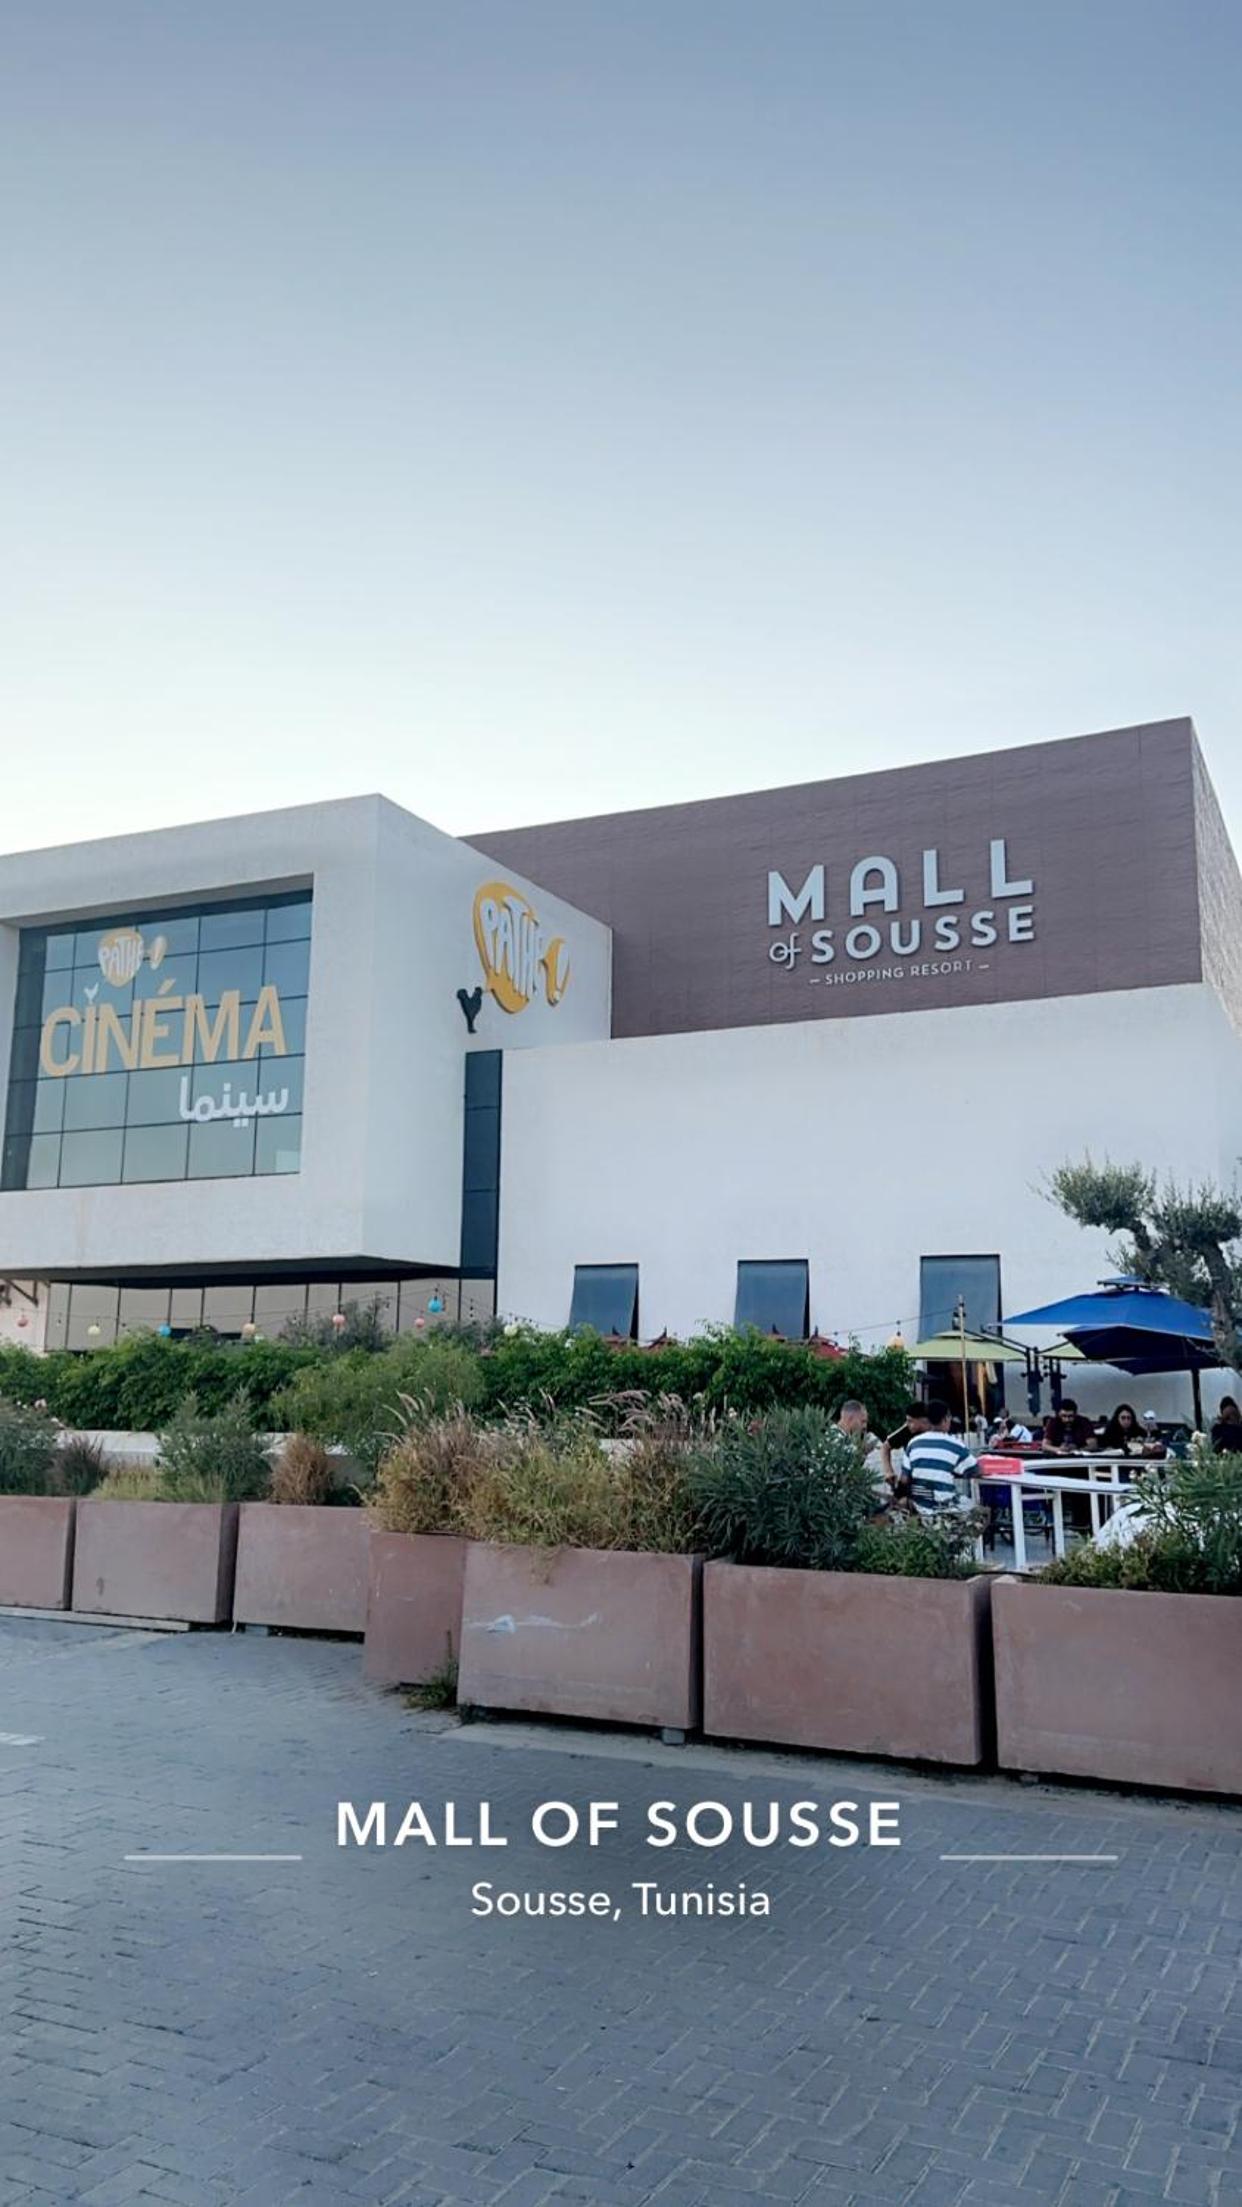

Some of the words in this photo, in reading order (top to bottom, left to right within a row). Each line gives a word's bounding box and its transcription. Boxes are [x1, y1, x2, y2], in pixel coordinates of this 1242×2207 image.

[767, 839, 1034, 926] MALL
[769, 932, 802, 970] of
[811, 905, 1035, 965] SOUSSE
[825, 966, 905, 986] SHOPPING
[910, 959, 974, 977] RESORT
[179, 1075, 289, 1128] سينما
